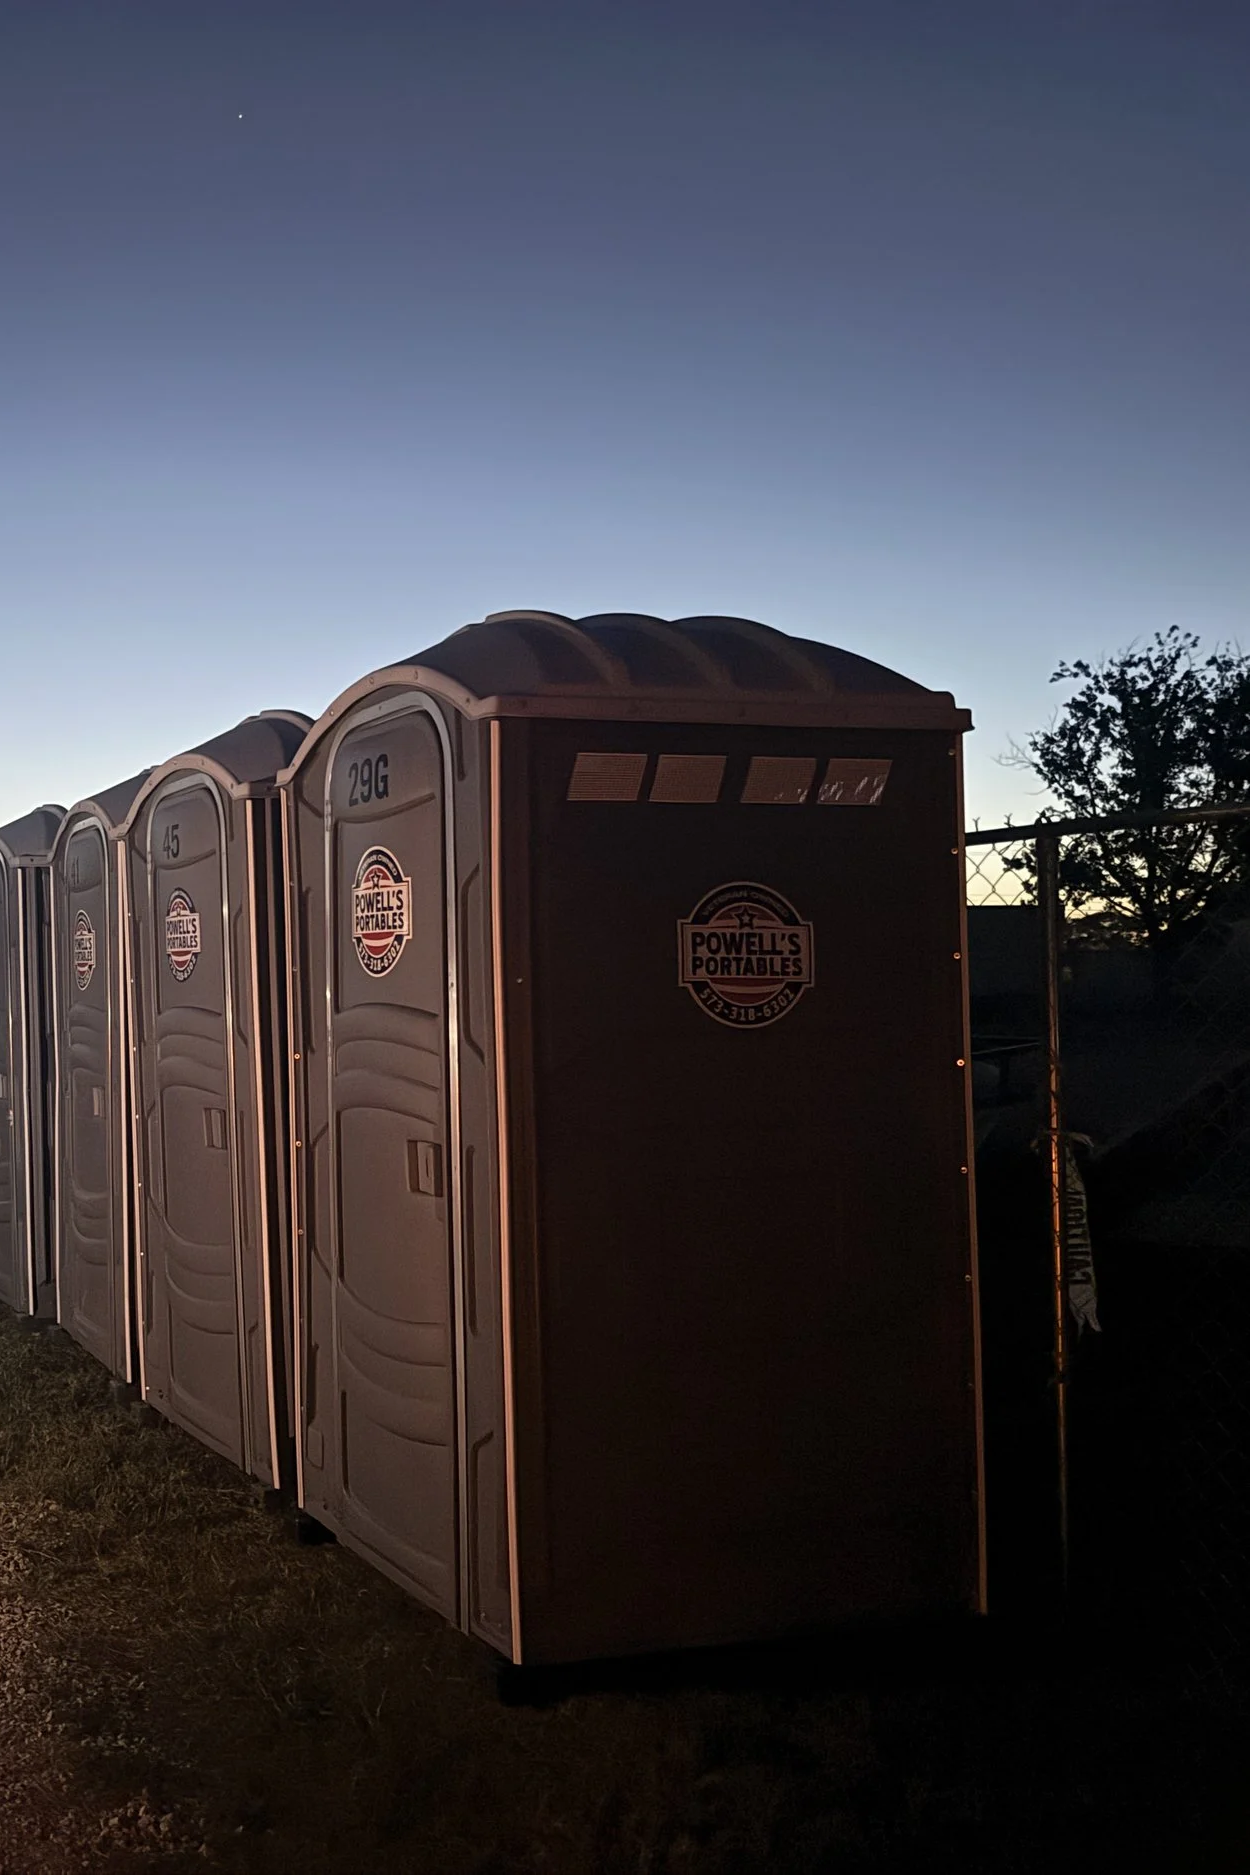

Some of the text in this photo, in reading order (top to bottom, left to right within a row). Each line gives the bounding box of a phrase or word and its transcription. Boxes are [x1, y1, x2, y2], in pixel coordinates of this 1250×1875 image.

[348, 754, 389, 807] 29G
[163, 824, 180, 859] 45
[355, 889, 404, 914] POWELL'S
[166, 917, 197, 936] POWELL'S
[355, 912, 405, 932] PORTABLES
[166, 935, 198, 950] PORTABLES
[691, 932, 801, 955] POWELL'S
[691, 956, 803, 976] PORTABLES
[699, 987, 795, 1022] 573-318-6302
